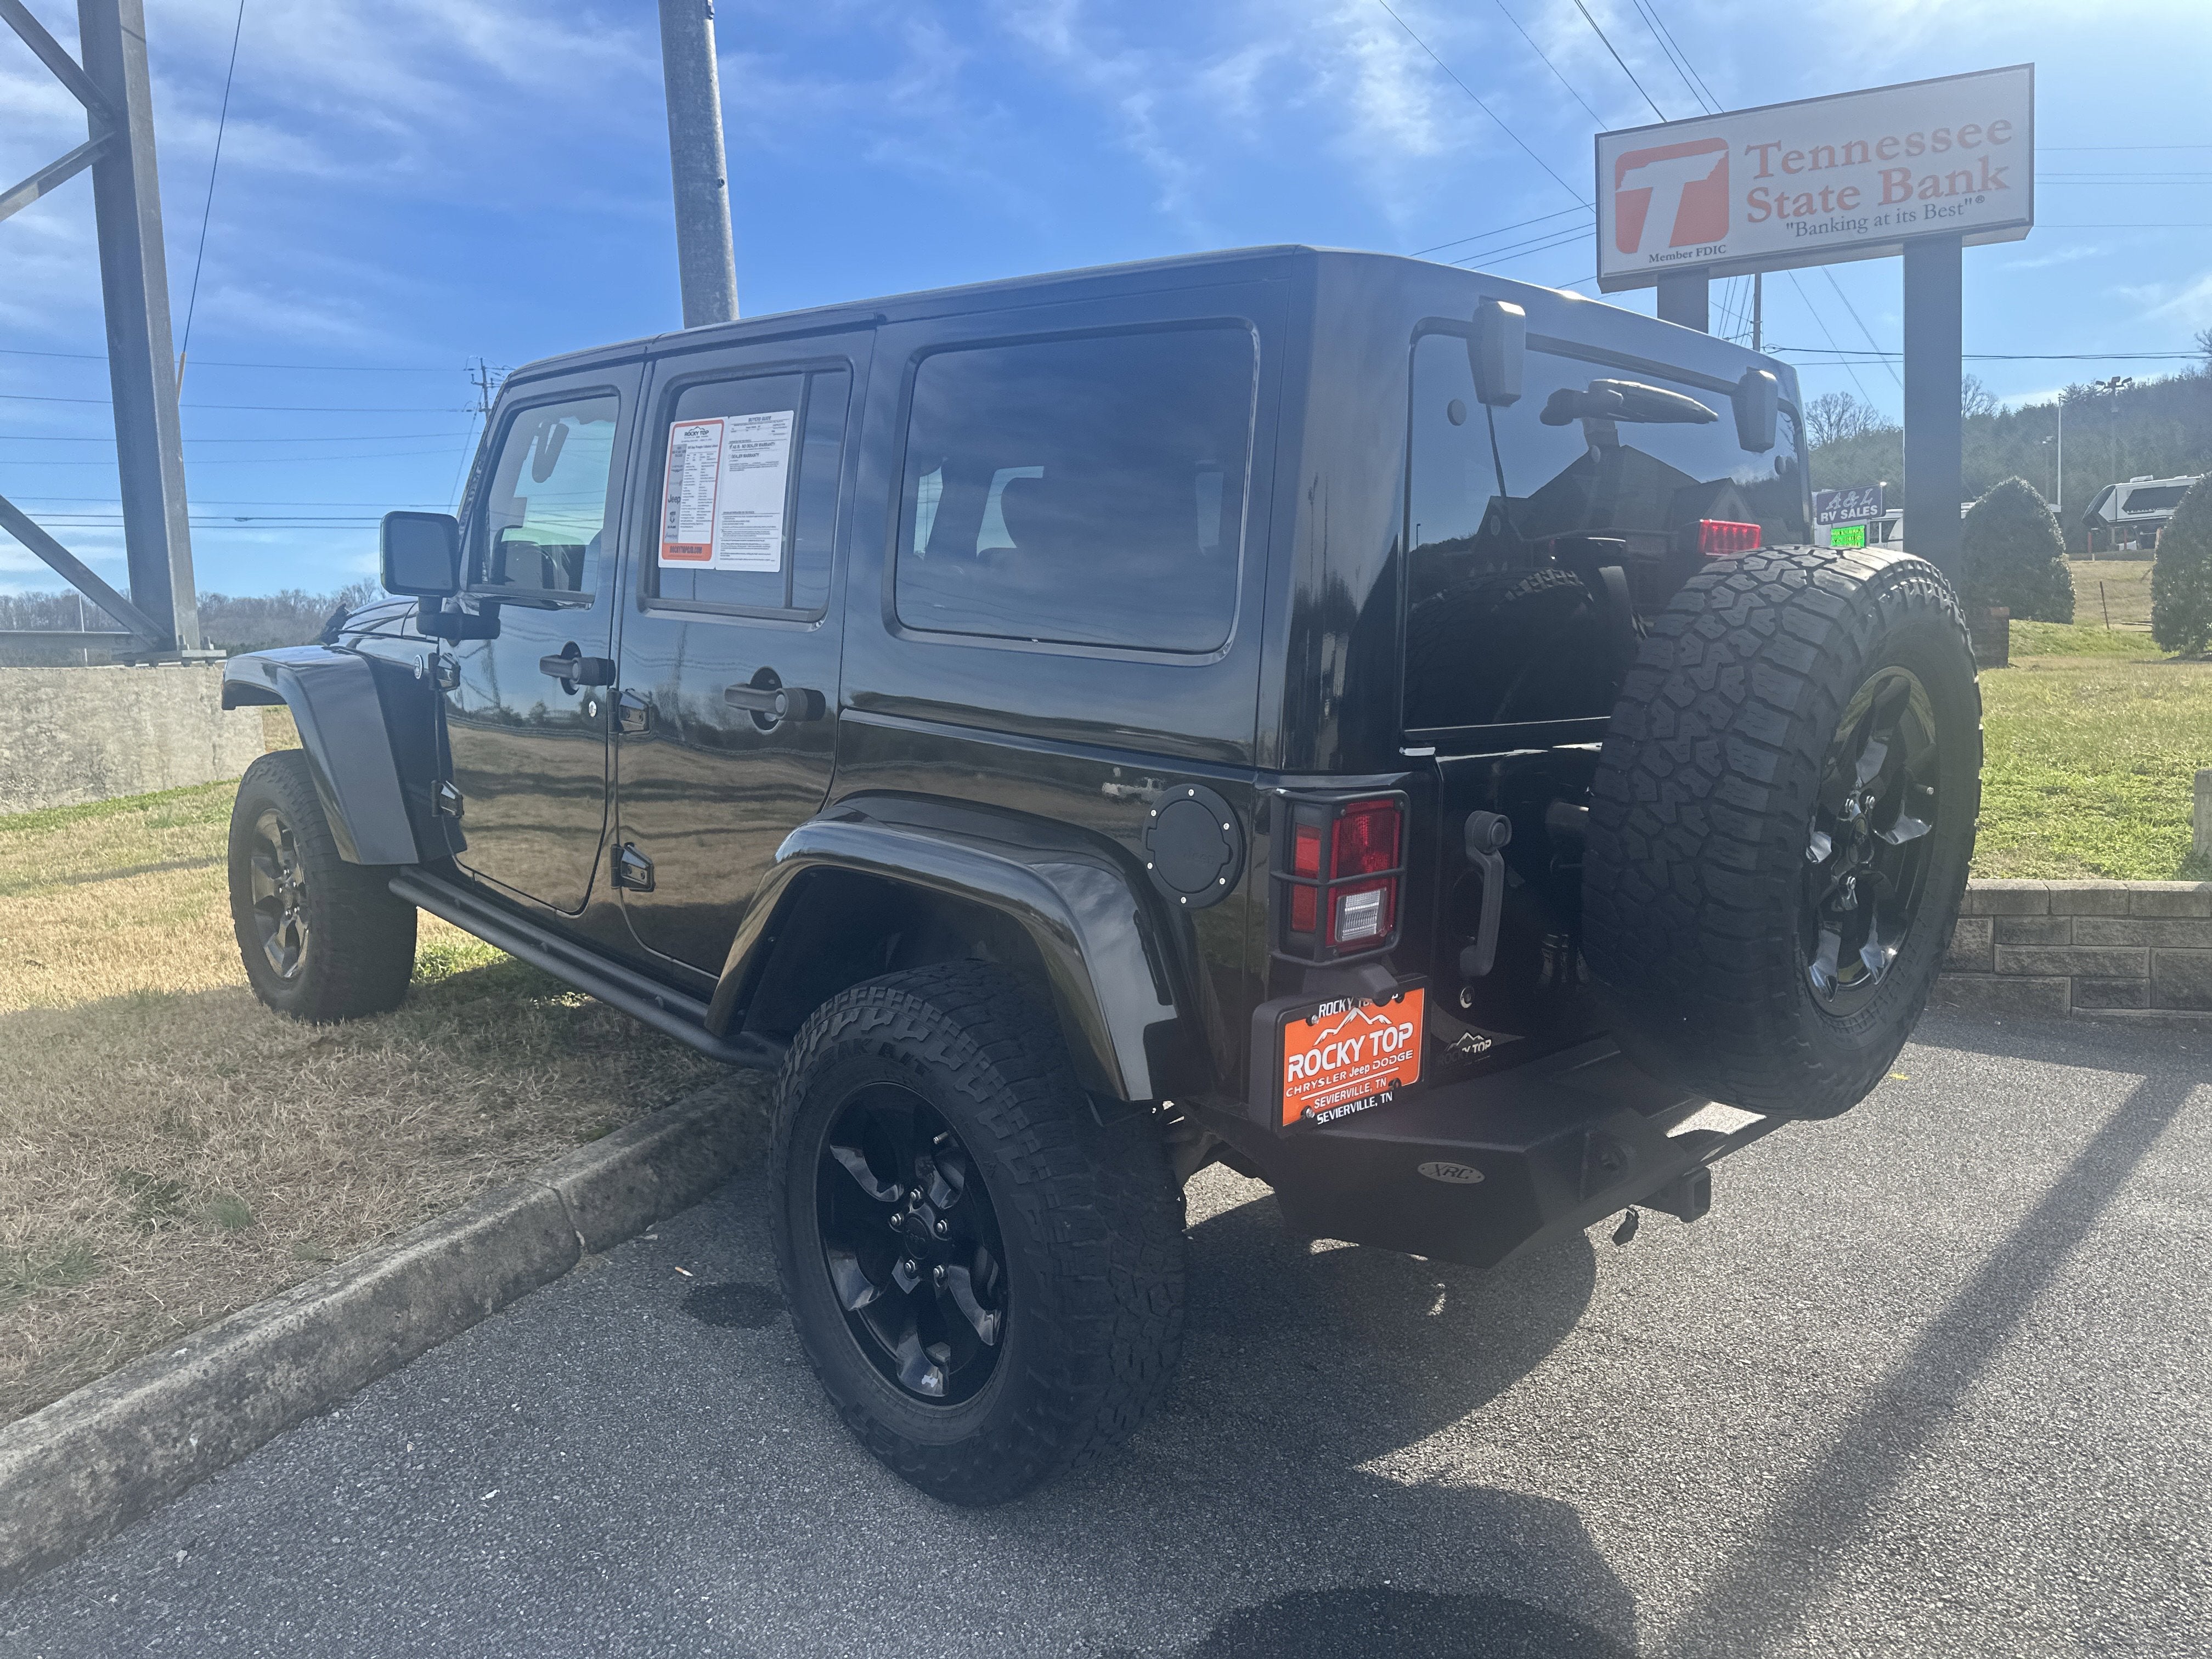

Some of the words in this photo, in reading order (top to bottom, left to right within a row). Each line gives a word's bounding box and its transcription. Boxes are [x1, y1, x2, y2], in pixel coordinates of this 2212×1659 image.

[1744, 119, 2012, 179] Tennessee
[1746, 185, 1860, 223] State
[1877, 155, 2010, 206] Bank
[1786, 216, 1867, 238] "Banking
[1874, 216, 1891, 227] at
[1897, 208, 1916, 223] its
[1649, 251, 1693, 263] Member
[1696, 245, 1726, 257] FDIC
[668, 494, 681, 505] Jeep
[1826, 492, 1841, 510] A
[1843, 490, 1859, 508] &
[1821, 510, 1837, 522] RV
[1840, 505, 1878, 520] SALES
[1318, 997, 1354, 1018] ROCKY
[1287, 1035, 1366, 1082] ROCKY
[1369, 1022, 1414, 1057] TOP
[1472, 1039, 1493, 1055] TOP
[1285, 1071, 1346, 1098] CHRYSLER
[1349, 1064, 1370, 1078] Jeep
[1372, 1049, 1414, 1070] DODGE
[1313, 1082, 1373, 1109] SEVIERVILLE,
[1375, 1077, 1387, 1089] TN
[1317, 1096, 1378, 1125] SEVIERVILLE,
[1380, 1091, 1393, 1104] TN
[1429, 1164, 1474, 1180] XRC
